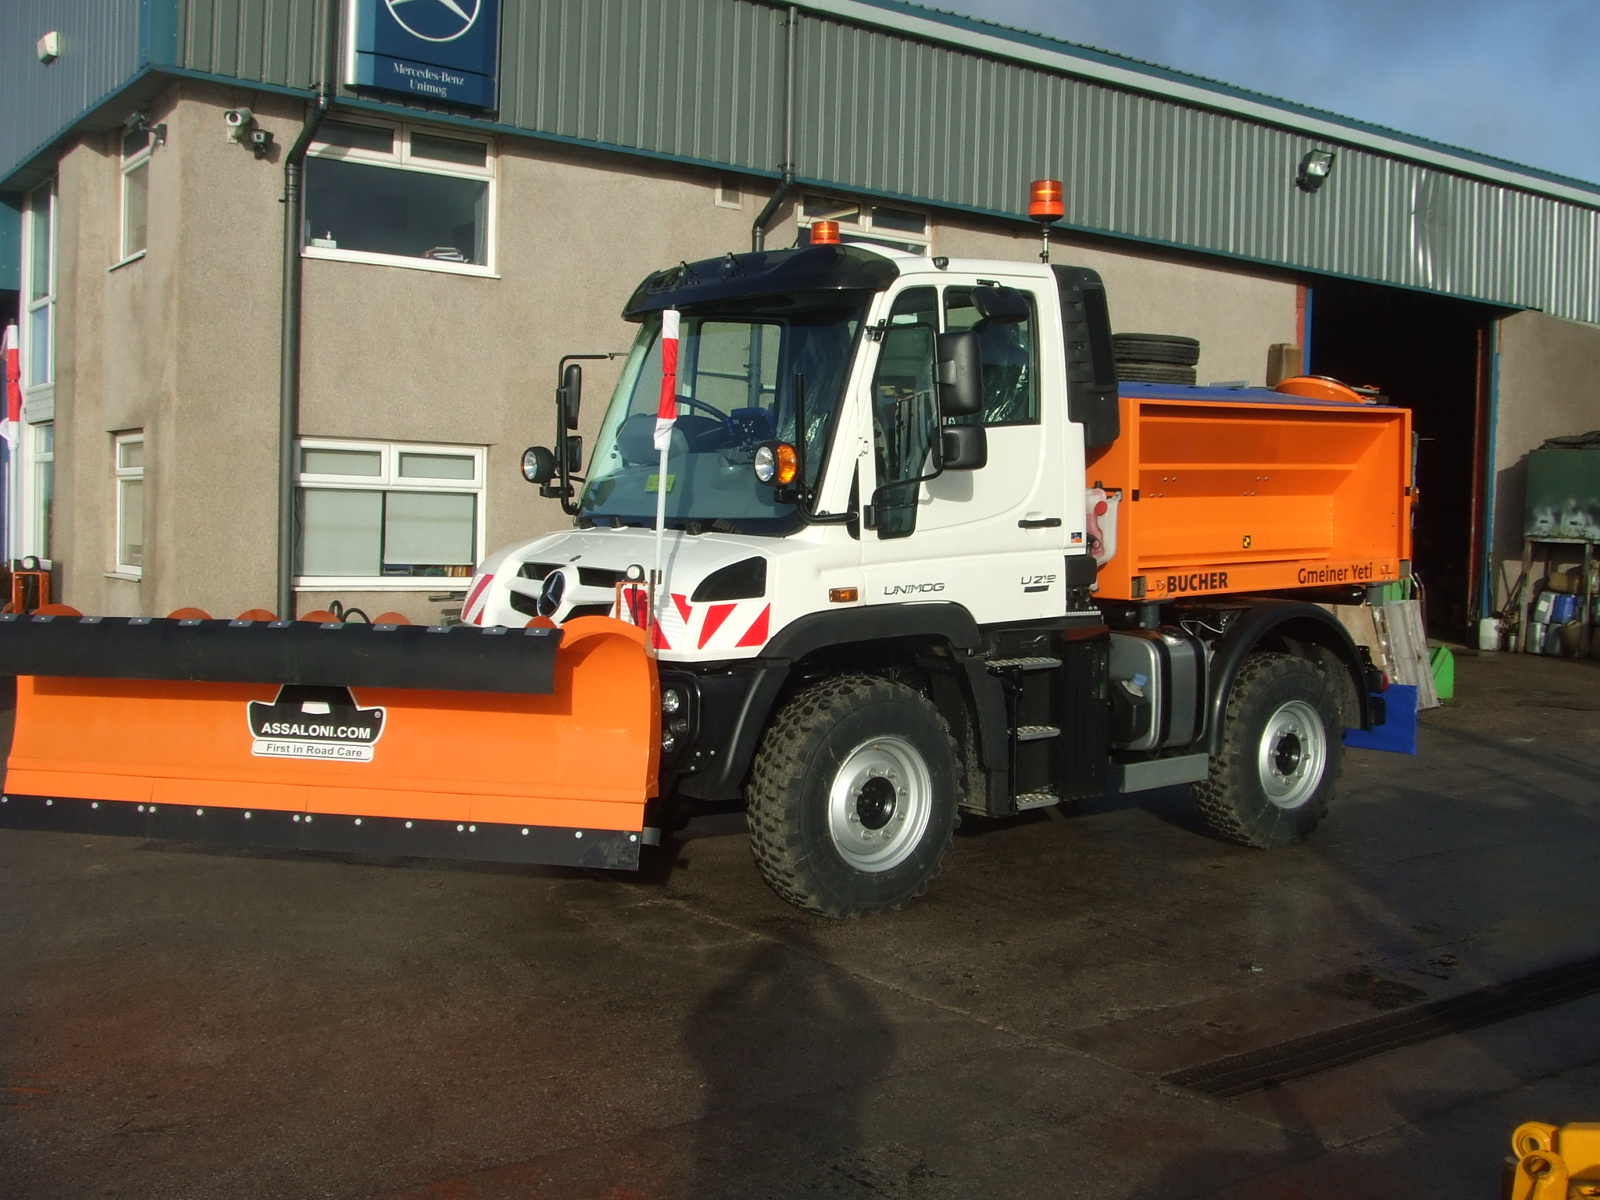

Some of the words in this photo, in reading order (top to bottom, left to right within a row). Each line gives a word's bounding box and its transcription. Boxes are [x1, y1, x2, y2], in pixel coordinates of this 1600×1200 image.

[393, 62, 465, 86] Mercedes-Benz
[409, 78, 448, 98] Unimog
[1166, 571, 1229, 593] BUCHER
[1297, 565, 1349, 585] Gmeiner
[1351, 562, 1374, 581] Yeti
[883, 582, 946, 596] UNIMOG
[260, 722, 372, 740] ASSALONI.COM
[266, 743, 291, 754] First
[293, 744, 304, 755] in
[306, 745, 335, 756] Road
[337, 747, 363, 758] Care
